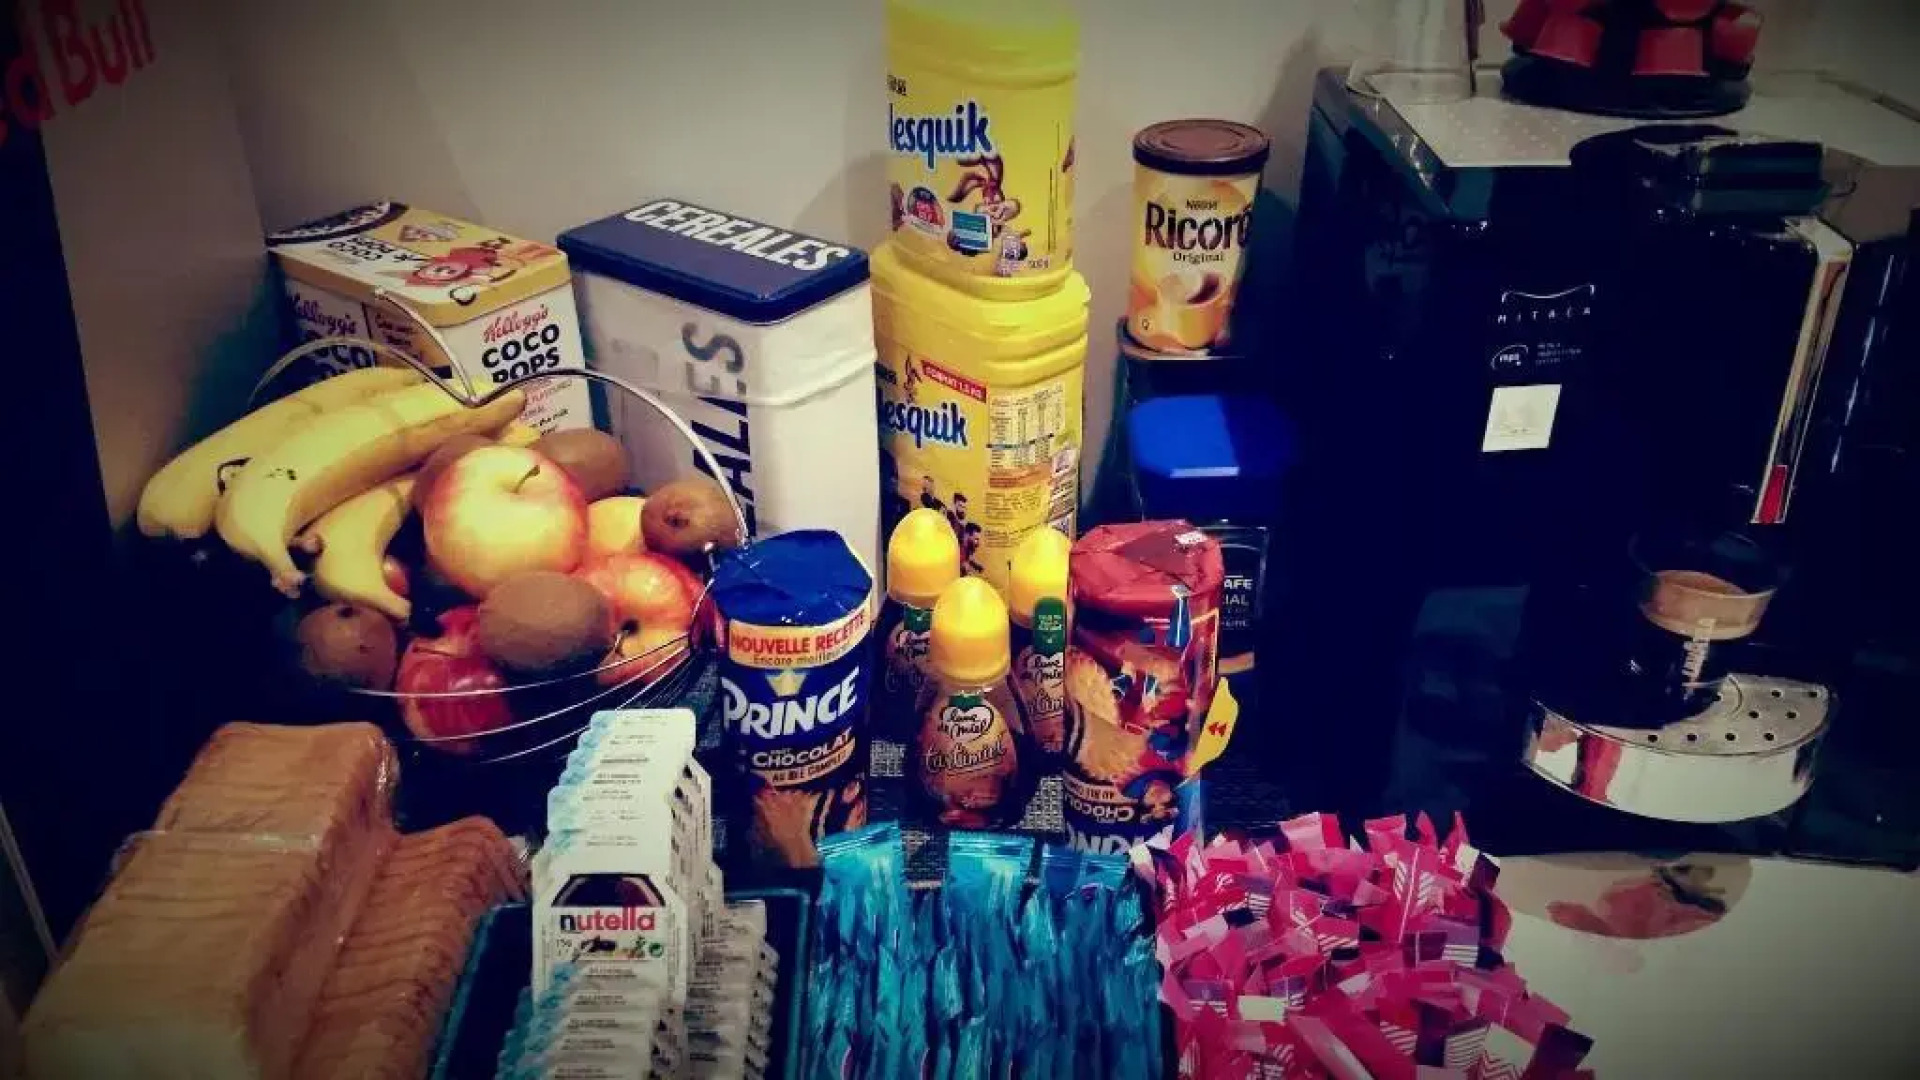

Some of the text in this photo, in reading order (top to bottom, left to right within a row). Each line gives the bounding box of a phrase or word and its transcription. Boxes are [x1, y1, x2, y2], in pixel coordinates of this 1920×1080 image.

[40, 0, 156, 106] Bull
[623, 200, 850, 271] CEREALES
[1173, 252, 1224, 265] Original
[483, 303, 549, 344] Kellogg's
[481, 323, 560, 368] COCO
[492, 346, 560, 383] POPS
[682, 321, 756, 537] ALES
[876, 388, 968, 448] esquik
[1223, 578, 1254, 590] AFE
[730, 610, 866, 655] NOUVELLE RECETTE
[753, 654, 793, 666] Encore
[721, 665, 860, 739] PRINCE
[752, 726, 853, 768] CHOCOLAT
[560, 907, 656, 931] nutella
